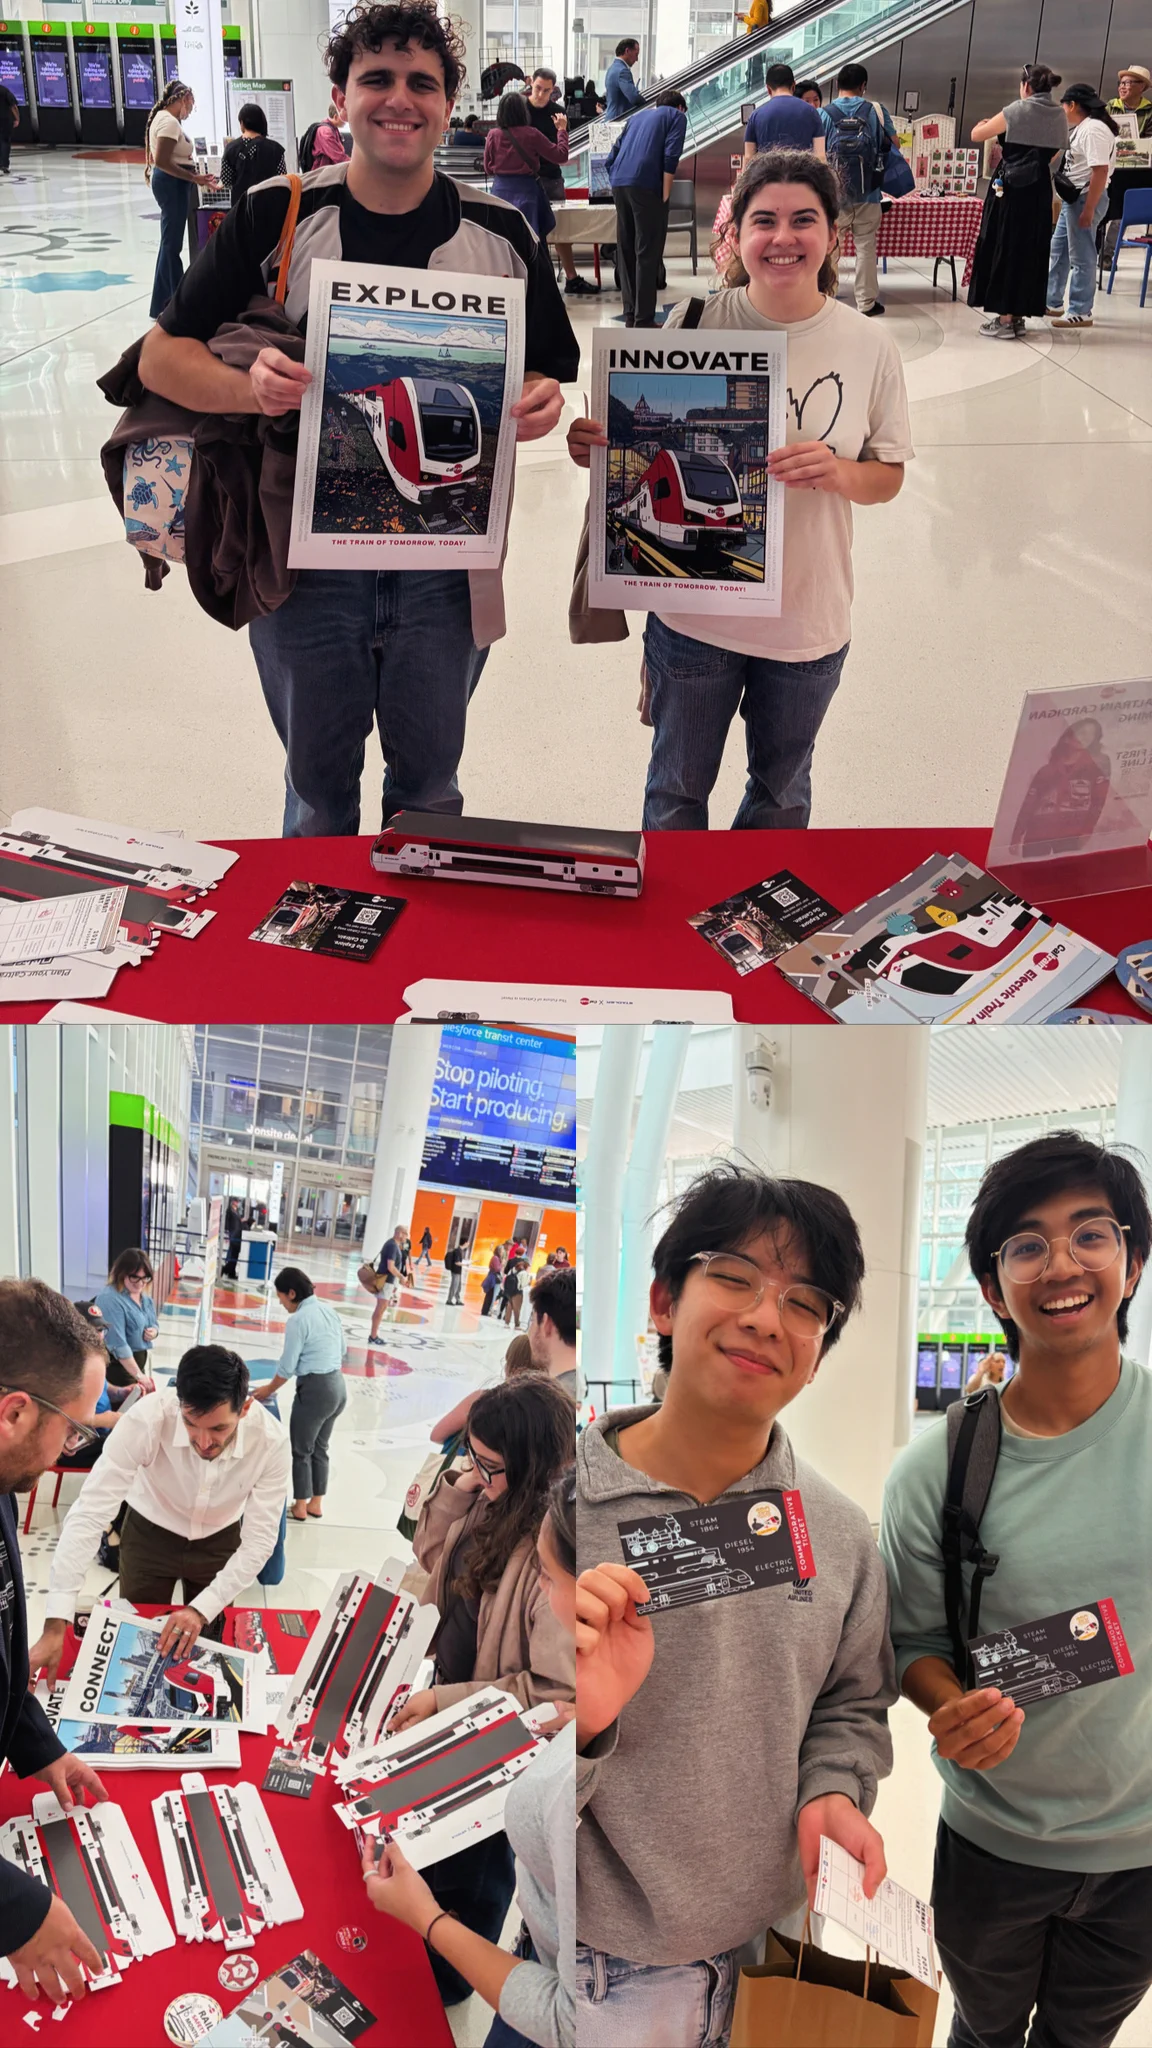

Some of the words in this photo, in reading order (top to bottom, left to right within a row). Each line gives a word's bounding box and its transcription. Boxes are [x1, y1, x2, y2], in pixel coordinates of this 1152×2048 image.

[252, 82, 266, 90] Map
[332, 281, 506, 316] EXPLORE
[610, 349, 768, 372] INNOVATE
[674, 582, 718, 591] TOMORROW,
[792, 909, 814, 924] Caltrain.
[813, 906, 821, 914] Go
[820, 910, 828, 918] Go
[799, 915, 820, 929] Explore.
[334, 940, 357, 950] Explore.
[337, 934, 359, 943] Caltrain.
[0, 970, 26, 978] Caltra
[50, 968, 72, 976] Plan
[1000, 969, 1038, 1000] Electric
[980, 998, 1004, 1020] Train
[442, 1024, 482, 1038] alesforce
[484, 1028, 514, 1044] transit
[515, 1035, 543, 1050] center
[434, 1058, 475, 1089] Stop
[476, 1068, 545, 1101] piloting.
[430, 1085, 474, 1112] Start
[474, 1096, 568, 1132] producing.
[254, 1126, 283, 1138] onsite
[284, 1132, 313, 1144] deal
[690, 1516, 718, 1528] STEAM
[700, 1524, 720, 1532] 1864
[786, 1496, 807, 1571] COMMEMORATIVE
[798, 1518, 808, 1547] TICKET
[724, 1538, 754, 1549] DIESEL
[737, 1546, 755, 1554] 1954
[755, 1558, 792, 1572] ELECTRIC
[776, 1566, 794, 1574] 2024
[788, 1594, 813, 1602] AIRLINES
[1022, 1628, 1046, 1640] STEAM
[1032, 1635, 1048, 1644] 1864
[1100, 1604, 1125, 1668] COMMEMORATIVE
[1112, 1622, 1125, 1647] TICKET
[1052, 1643, 1077, 1656] DIESEL
[1064, 1650, 1079, 1658] 1954
[80, 1618, 117, 1712] CONNECT
[1080, 1657, 1112, 1672] ELECTRIC
[1098, 1664, 1114, 1674] 2024
[48, 1687, 66, 1726] OVATE
[186, 2018, 200, 2038] MONTH
[192, 2014, 206, 2034] SAFETY
[198, 2010, 214, 2032] RAIL
